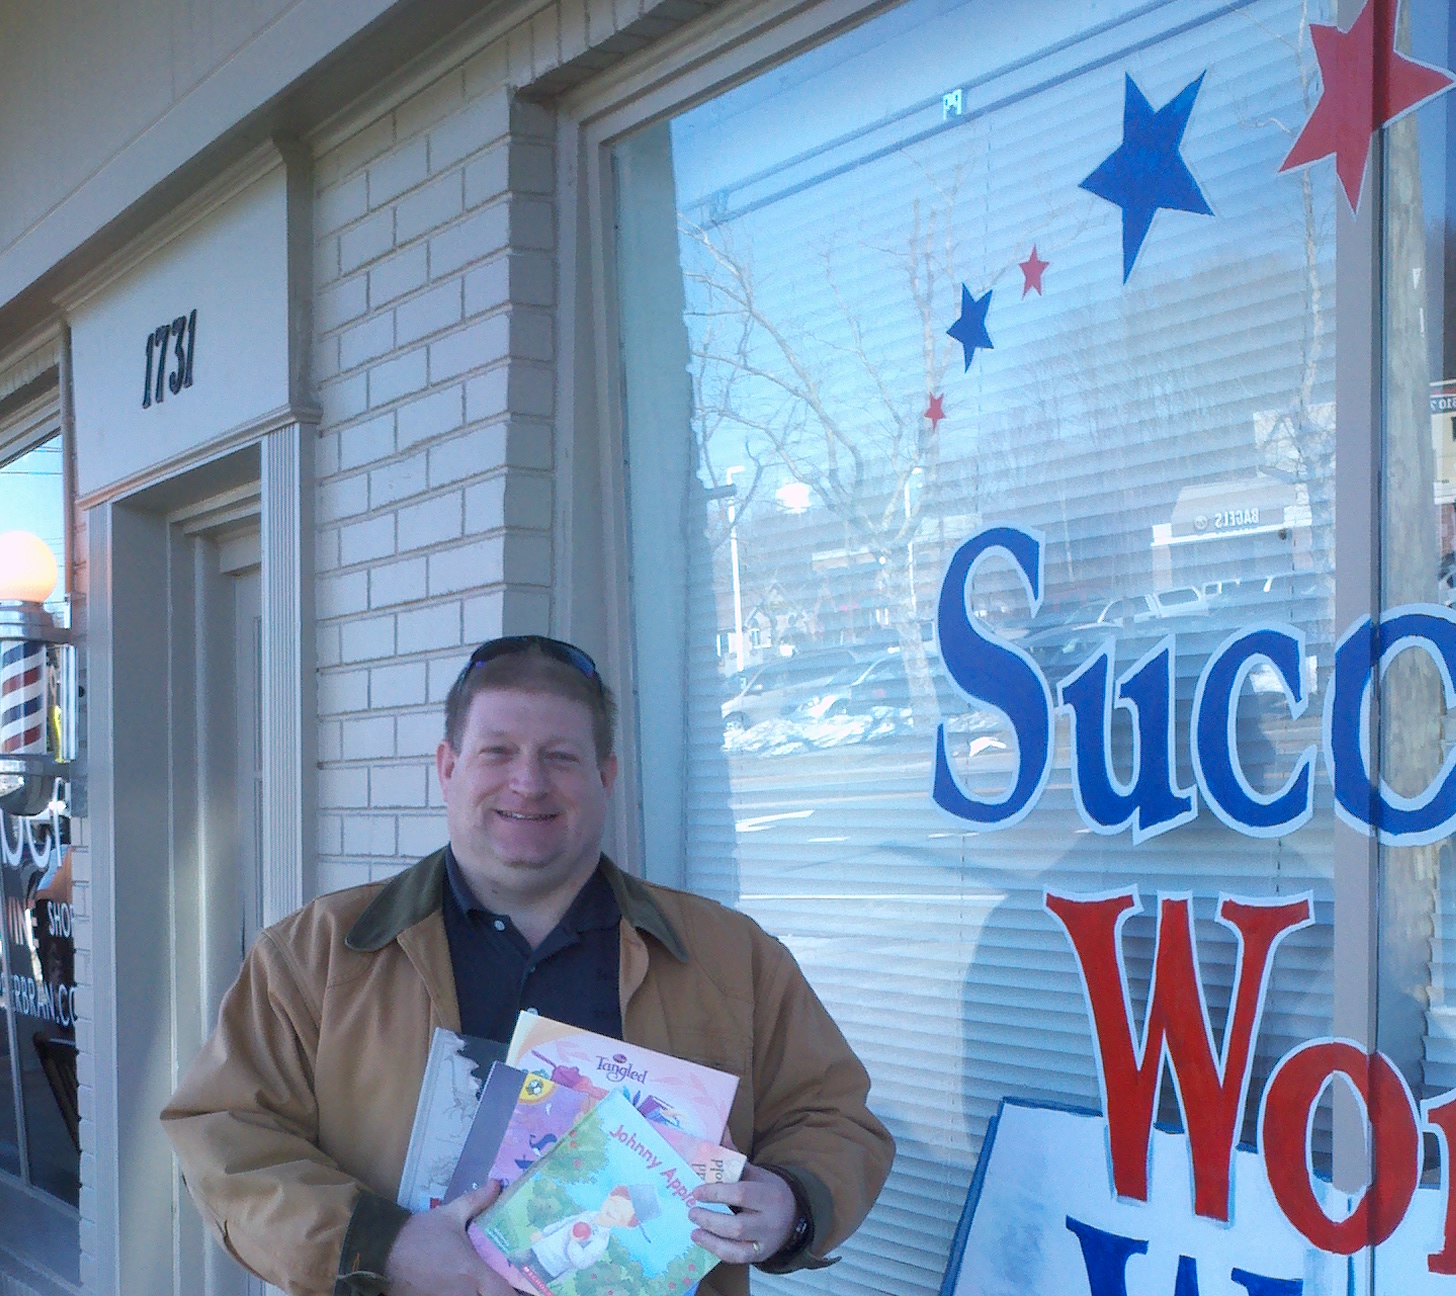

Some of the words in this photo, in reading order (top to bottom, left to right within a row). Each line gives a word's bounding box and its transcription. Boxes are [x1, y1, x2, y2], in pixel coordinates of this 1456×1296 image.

[142, 309, 197, 409] 1731
[596, 1055, 648, 1085] Tangled
[609, 1124, 662, 1169] Johnny
